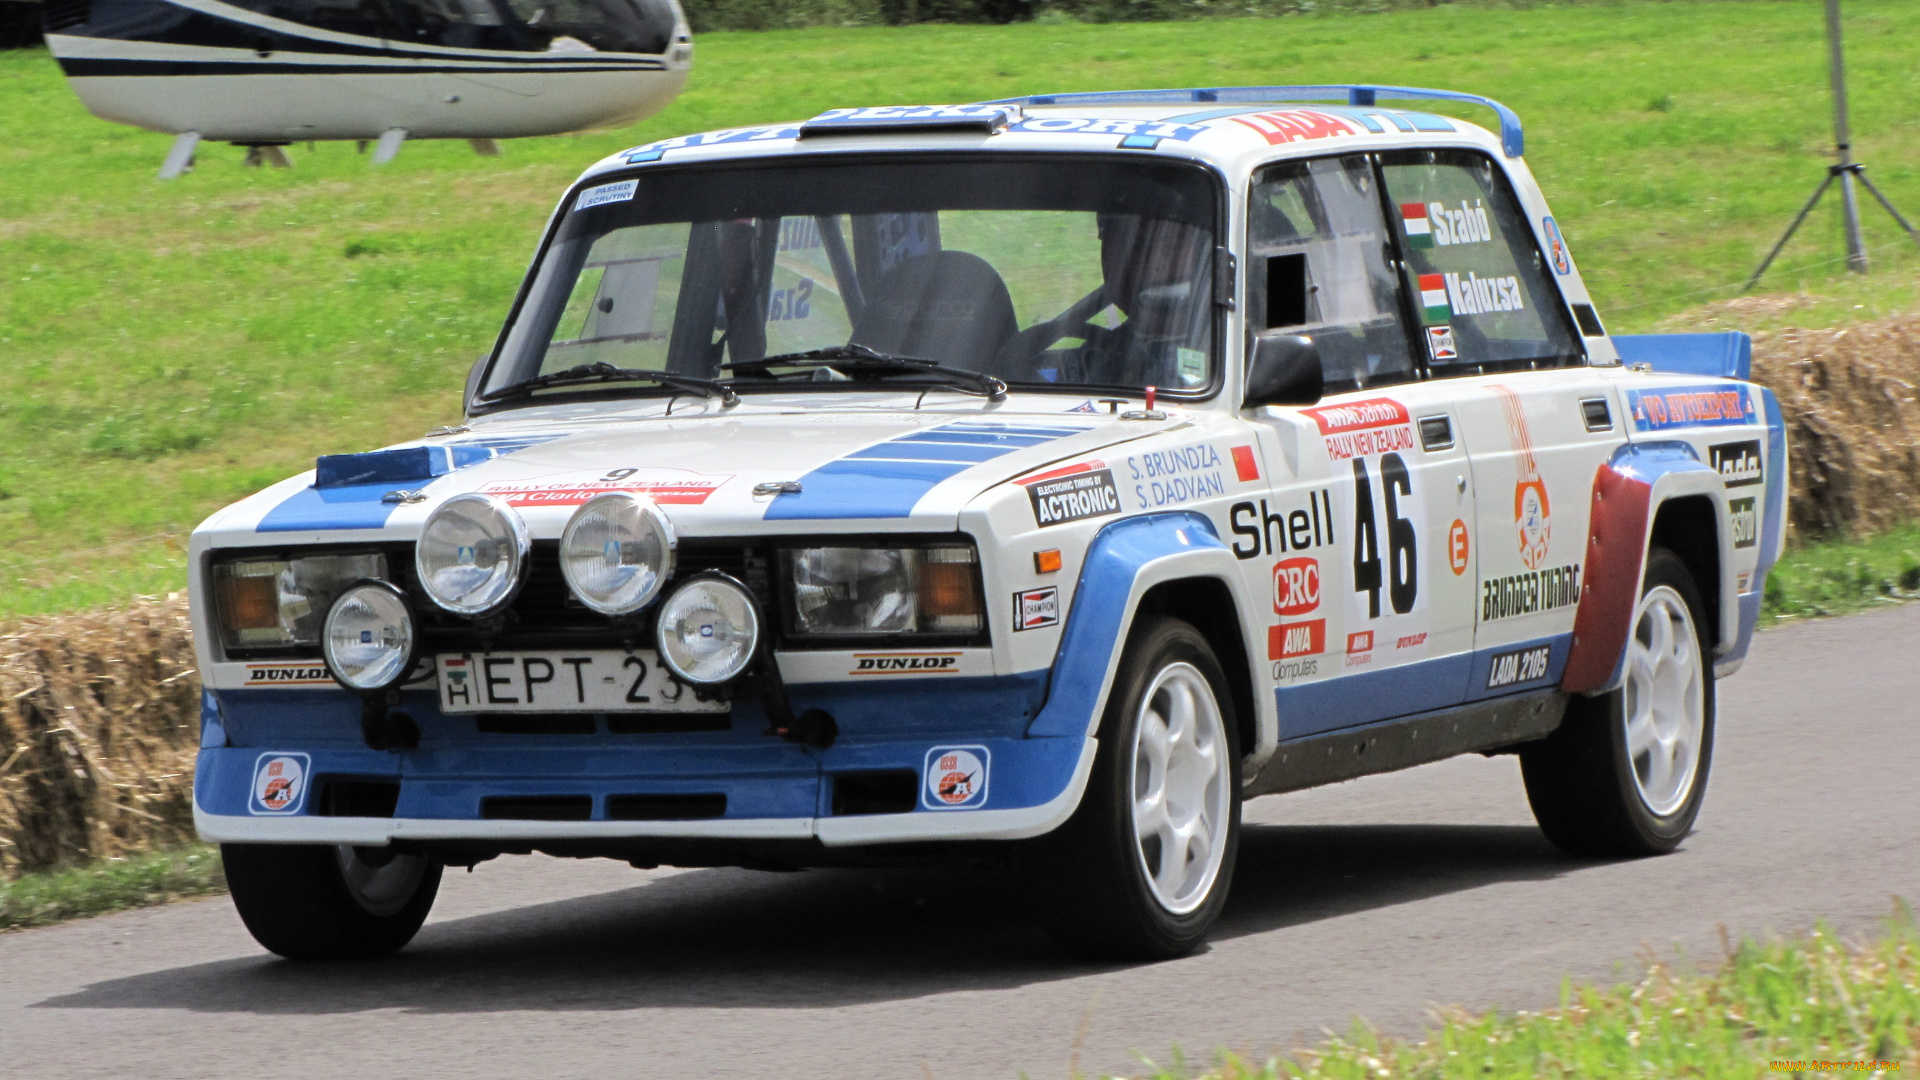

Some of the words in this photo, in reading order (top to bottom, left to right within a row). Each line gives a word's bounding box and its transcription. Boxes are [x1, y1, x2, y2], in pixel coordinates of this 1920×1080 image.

[1229, 110, 1356, 146] LADA
[587, 191, 634, 205] SCRUTINY
[595, 183, 631, 194] PASSED
[1429, 198, 1491, 246] Szabó
[1444, 271, 1524, 316] Kaluzsa
[1665, 391, 1744, 422] AVTOEXPORT
[1326, 434, 1354, 461] RALLY
[1352, 431, 1375, 456] NEW
[1374, 427, 1414, 453] ZEALAND
[599, 468, 639, 481] 9
[1128, 457, 1144, 480] S.
[1142, 444, 1221, 479] BRUNDZA
[528, 491, 602, 501] Clario
[1037, 482, 1074, 497] ELECTRONIC
[1073, 477, 1094, 492] TIMING
[1135, 485, 1151, 509] S.
[1152, 472, 1225, 507] DADVANI
[1038, 486, 1117, 523] ACTRONIC
[1230, 489, 1334, 560] Shell
[1352, 452, 1418, 620] 46
[1451, 527, 1466, 568] E
[1274, 564, 1319, 609] CRC
[1026, 602, 1054, 615] CHAMPION
[1283, 626, 1311, 655] AWA
[1352, 633, 1369, 650] AWA
[1396, 631, 1427, 649] DUNLOP
[857, 657, 956, 669] DUNLOP
[1272, 658, 1317, 683] Computers
[1345, 653, 1371, 668] Computers
[1488, 654, 1518, 687] LADA
[1518, 647, 1549, 681] 2105
[447, 684, 470, 705] H
